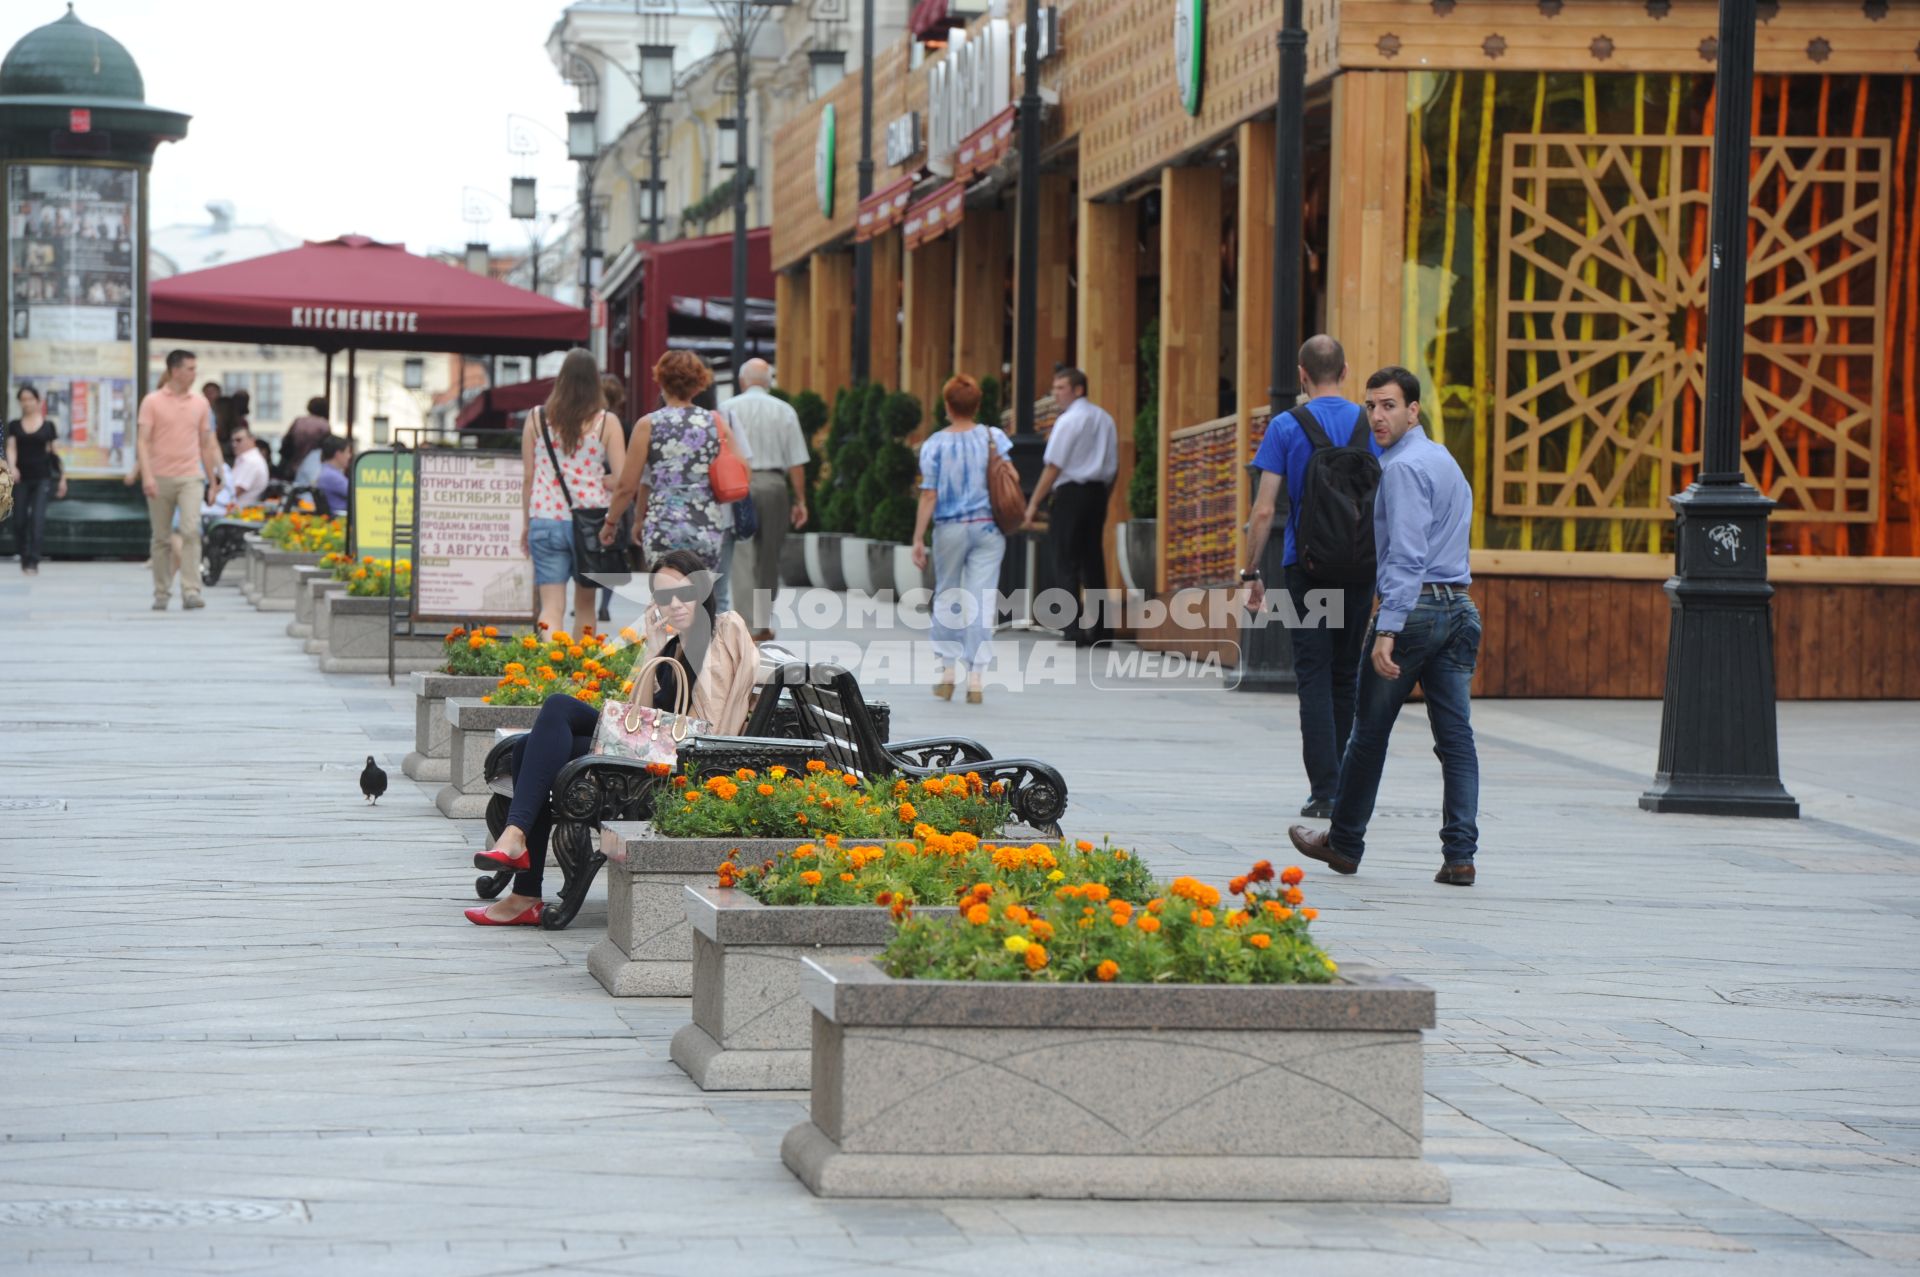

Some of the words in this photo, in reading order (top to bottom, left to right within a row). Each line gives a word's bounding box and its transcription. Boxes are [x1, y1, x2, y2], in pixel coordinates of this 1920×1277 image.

[291, 306, 418, 332] KITCHENETTE
[421, 477, 486, 489] ОТКРЫТИЕ
[421, 490, 429, 502] 3
[433, 490, 501, 504] СЕНТЯБРЯ
[421, 511, 511, 521] ПРЕДВАРИТЕЛЬНАЯ
[421, 521, 466, 532] ПРОДАЖА
[468, 522, 510, 532] БИЛЕТОВ
[420, 532, 433, 541] НА
[436, 532, 486, 543] СЕНТЯБРЬ
[489, 534, 510, 543] 2013
[433, 544, 441, 555] 3
[446, 544, 510, 557] АВГУСТА
